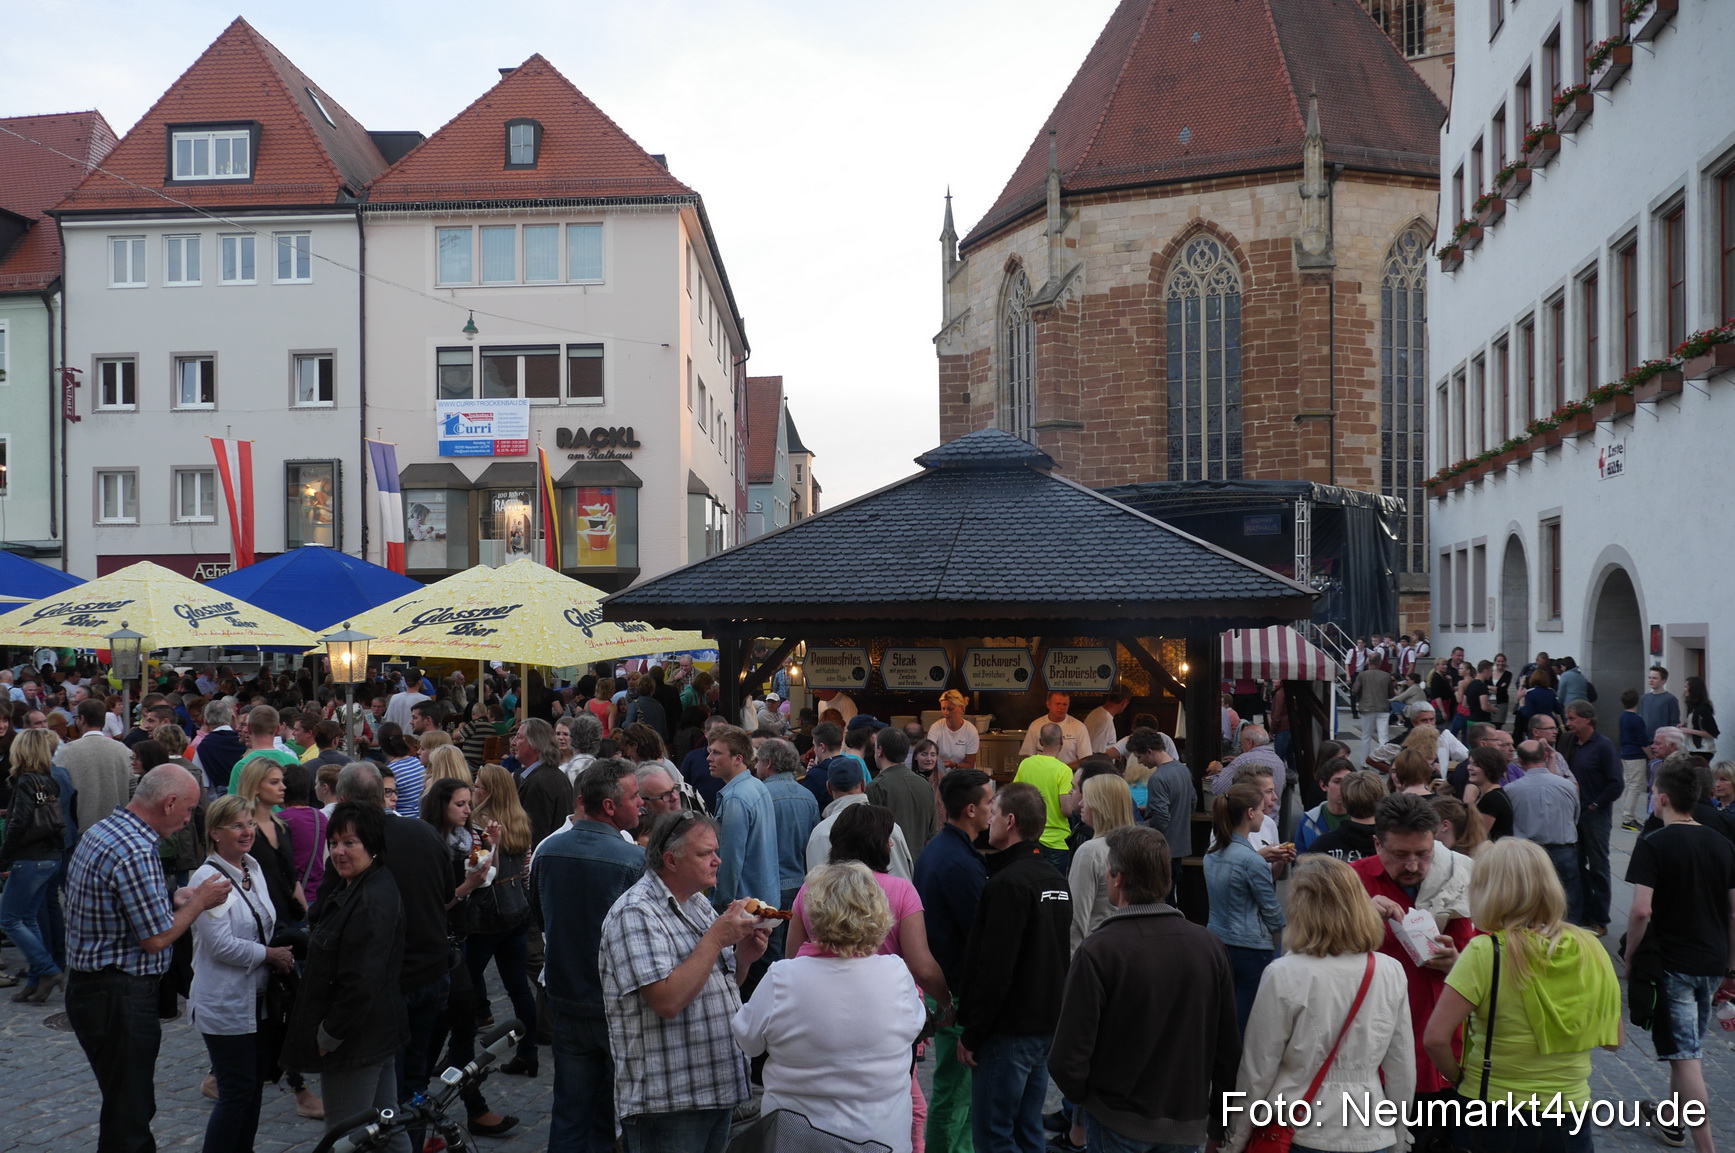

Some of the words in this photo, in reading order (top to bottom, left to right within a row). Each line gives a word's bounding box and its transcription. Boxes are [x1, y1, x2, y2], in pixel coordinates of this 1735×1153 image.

[453, 423, 492, 435] Curri
[556, 426, 641, 448] RACKL
[587, 447, 633, 460] Rathaus
[19, 599, 136, 627] Glossner
[173, 601, 240, 629] Glossner
[398, 603, 524, 635] Glossner
[60, 614, 109, 628] Bier
[224, 616, 259, 629] Bier
[446, 621, 498, 637] Bier
[810, 651, 862, 667] Pommesfrites
[892, 652, 917, 667] Steak
[972, 653, 1022, 667] Bockwurst
[1048, 665, 1097, 679] Bratwürste
